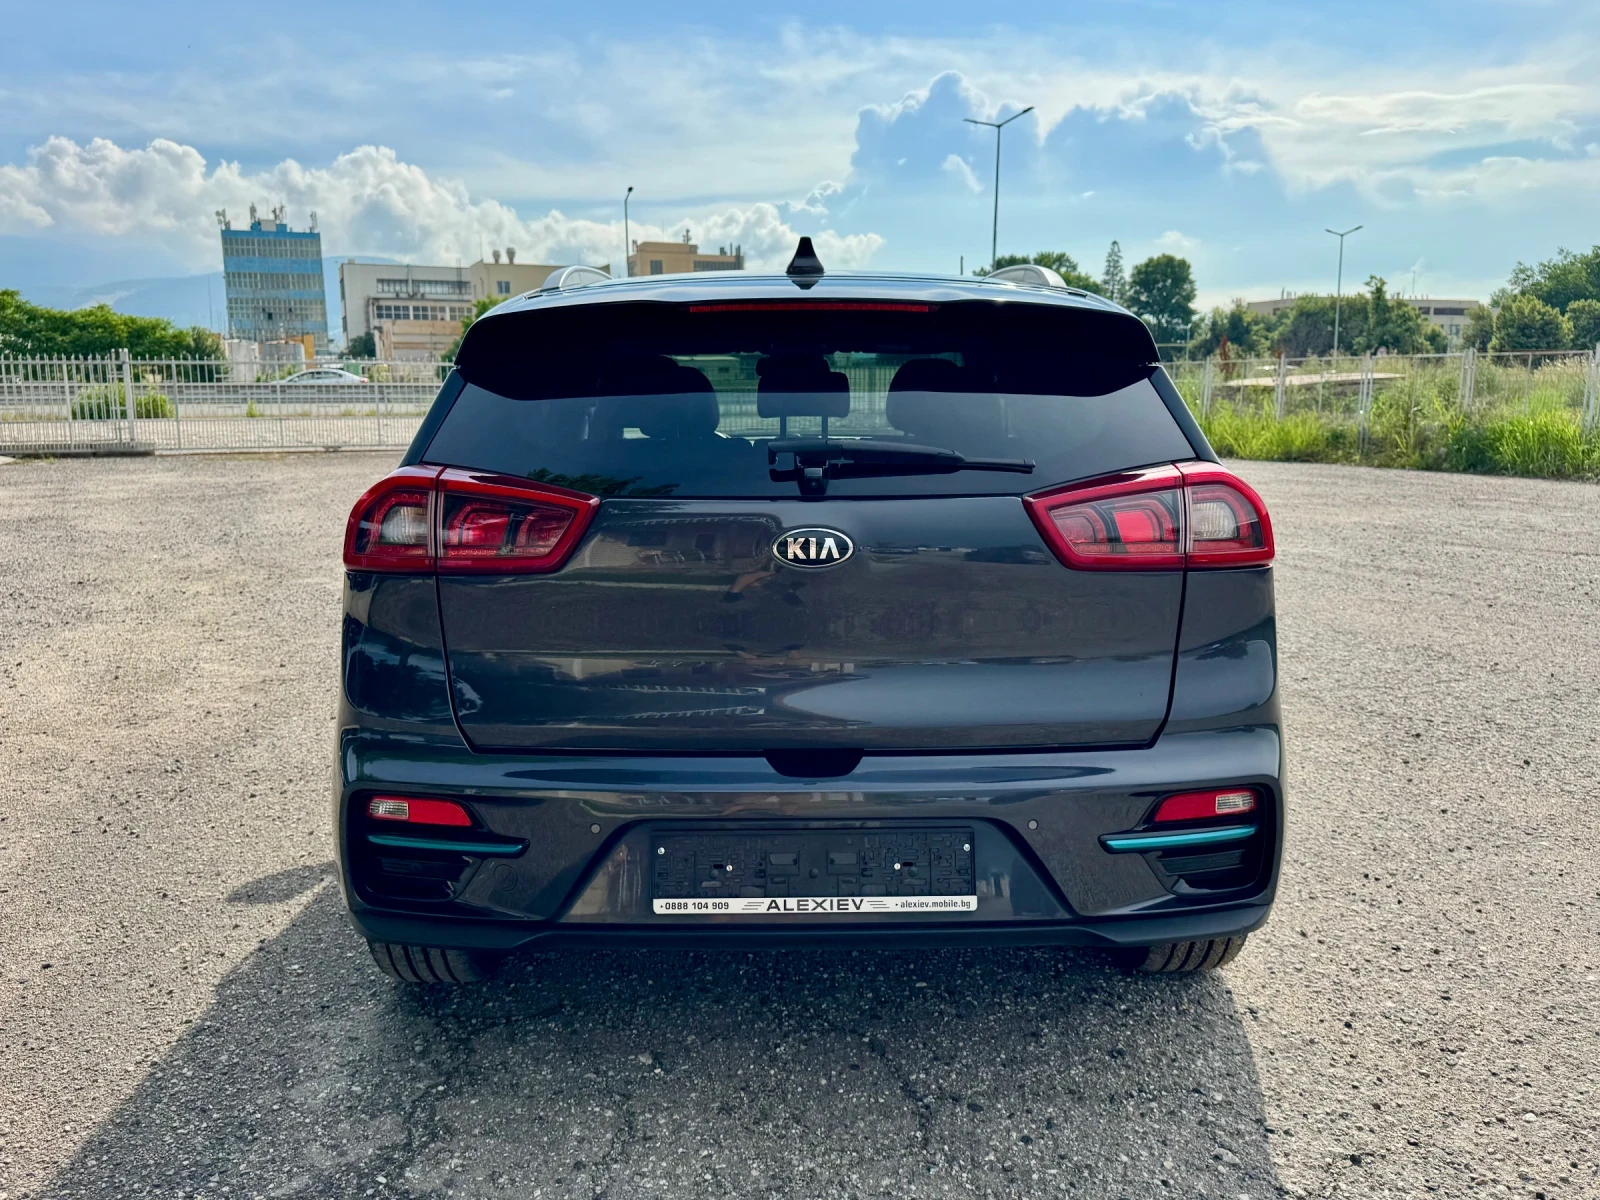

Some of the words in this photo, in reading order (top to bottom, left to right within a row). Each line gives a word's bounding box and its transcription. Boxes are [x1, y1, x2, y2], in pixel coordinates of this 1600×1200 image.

[786, 537, 840, 560] KIA
[665, 901, 688, 911] 0888
[691, 901, 709, 911] 104
[711, 901, 730, 910] 909
[766, 898, 865, 912] ALEXIEV
[900, 899, 971, 910] alexiev.mobile.bg
